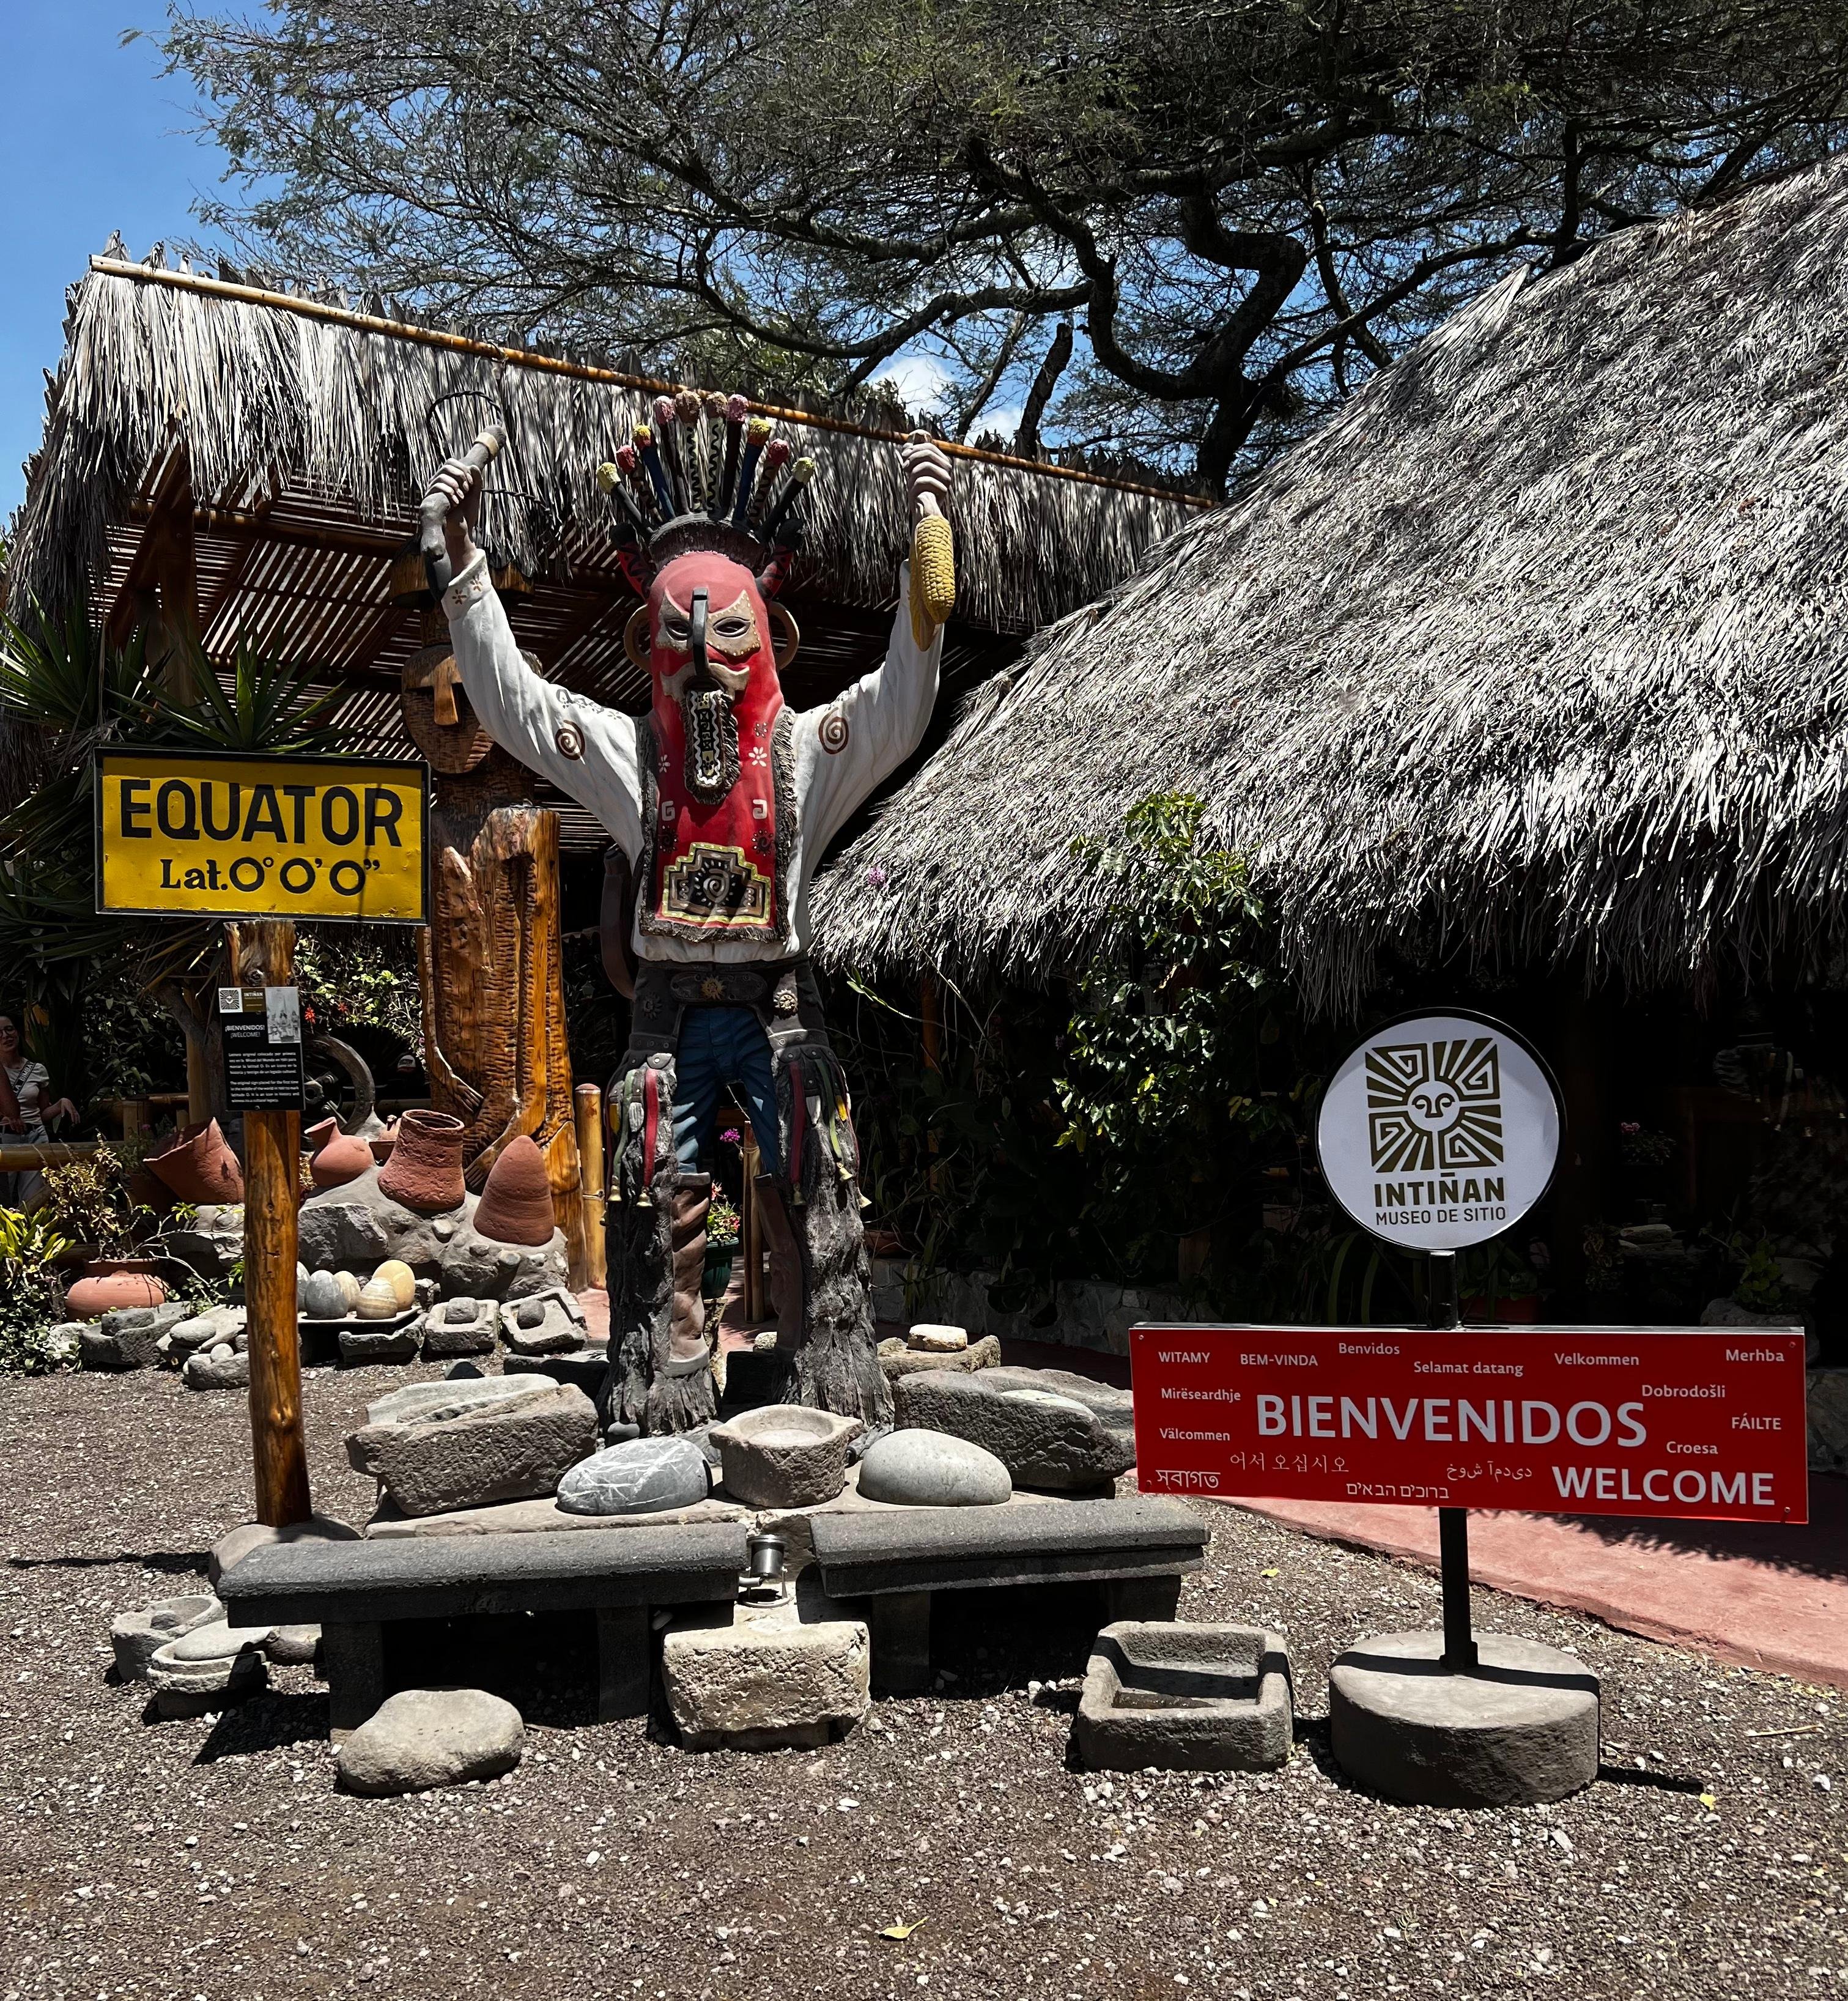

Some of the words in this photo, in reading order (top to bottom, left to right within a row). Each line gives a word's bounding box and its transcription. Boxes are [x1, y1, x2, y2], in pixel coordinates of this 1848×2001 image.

[120, 779, 402, 847] EQUATOR
[1374, 1172, 1505, 1207] INTIÑAN
[1376, 1210, 1431, 1226] MUSEO
[1437, 1208, 1458, 1223] DE
[1463, 1207, 1506, 1222] SITIO
[1338, 1342, 1400, 1355] Benvidos
[1726, 1349, 1784, 1362] Merhba
[1158, 1352, 1210, 1364] WITAMY
[1240, 1353, 1318, 1367] BEM-VINDA
[1554, 1353, 1639, 1366] Velkommen
[1414, 1361, 1468, 1374] Selamat
[1473, 1362, 1524, 1377] datang
[1161, 1387, 1241, 1403] Mirëseardhje
[1641, 1384, 1726, 1398] Dobrodošli
[1257, 1394, 1647, 1447] BIENVENIDOS
[1731, 1413, 1781, 1430] FÁILTE
[1159, 1427, 1230, 1441] Välcommen
[1666, 1441, 1718, 1454] Croesa
[1230, 1451, 1265, 1471] 어서
[1272, 1454, 1349, 1474] 오십시오
[1347, 1482, 1396, 1497] הבאים
[1400, 1485, 1449, 1500] ברוכים
[1552, 1466, 1775, 1506] WELCOME
